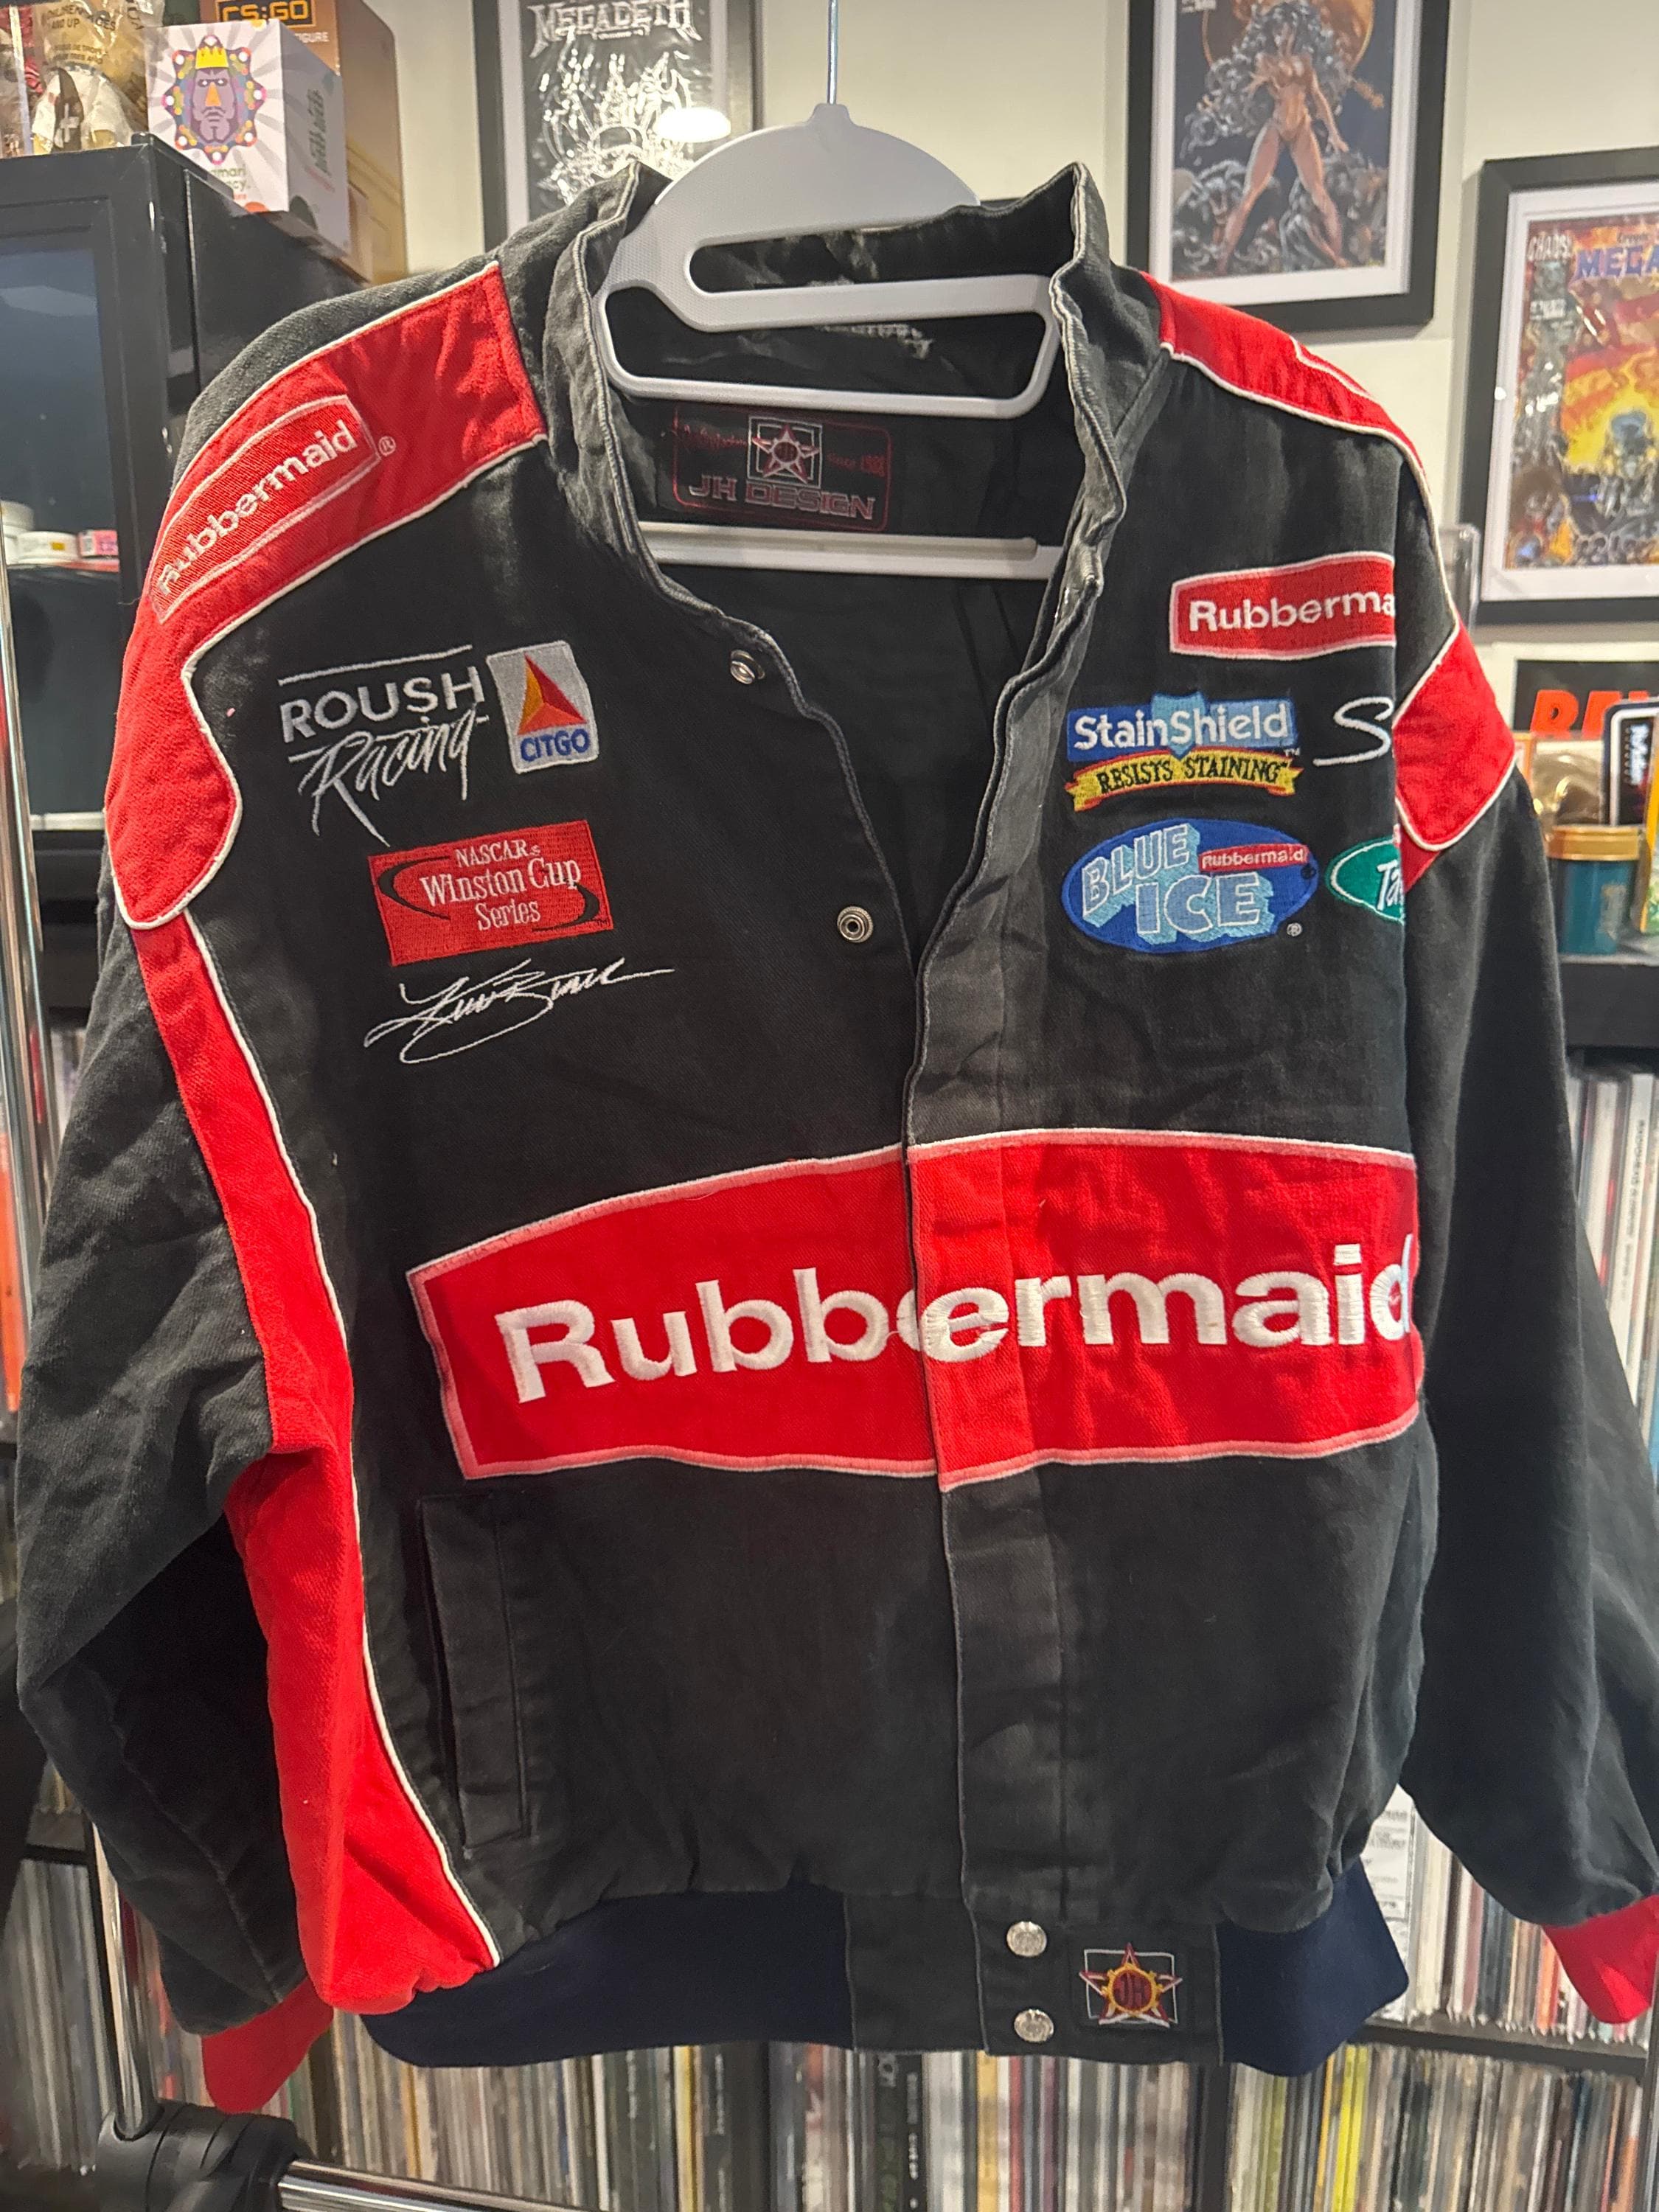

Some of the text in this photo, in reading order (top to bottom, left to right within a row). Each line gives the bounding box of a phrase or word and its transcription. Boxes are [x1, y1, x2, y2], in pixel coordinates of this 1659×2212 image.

[157, 419, 358, 597] Rubbermaid
[689, 474, 876, 520] JH DESIGN
[278, 665, 486, 743] ROUSH
[1074, 702, 1288, 751] StainShield
[519, 728, 590, 763] CITGO
[297, 705, 479, 847] Racing
[1096, 754, 1281, 793] RESISTS STAINING
[454, 839, 529, 869] NASCAR
[1082, 823, 1191, 918] BLUE
[1202, 848, 1304, 869] Rubbermaid
[419, 857, 582, 907] Winston Cup
[1135, 872, 1260, 934] ICE
[474, 897, 541, 931] Series
[495, 1234, 1413, 1403] Rubbermaid
